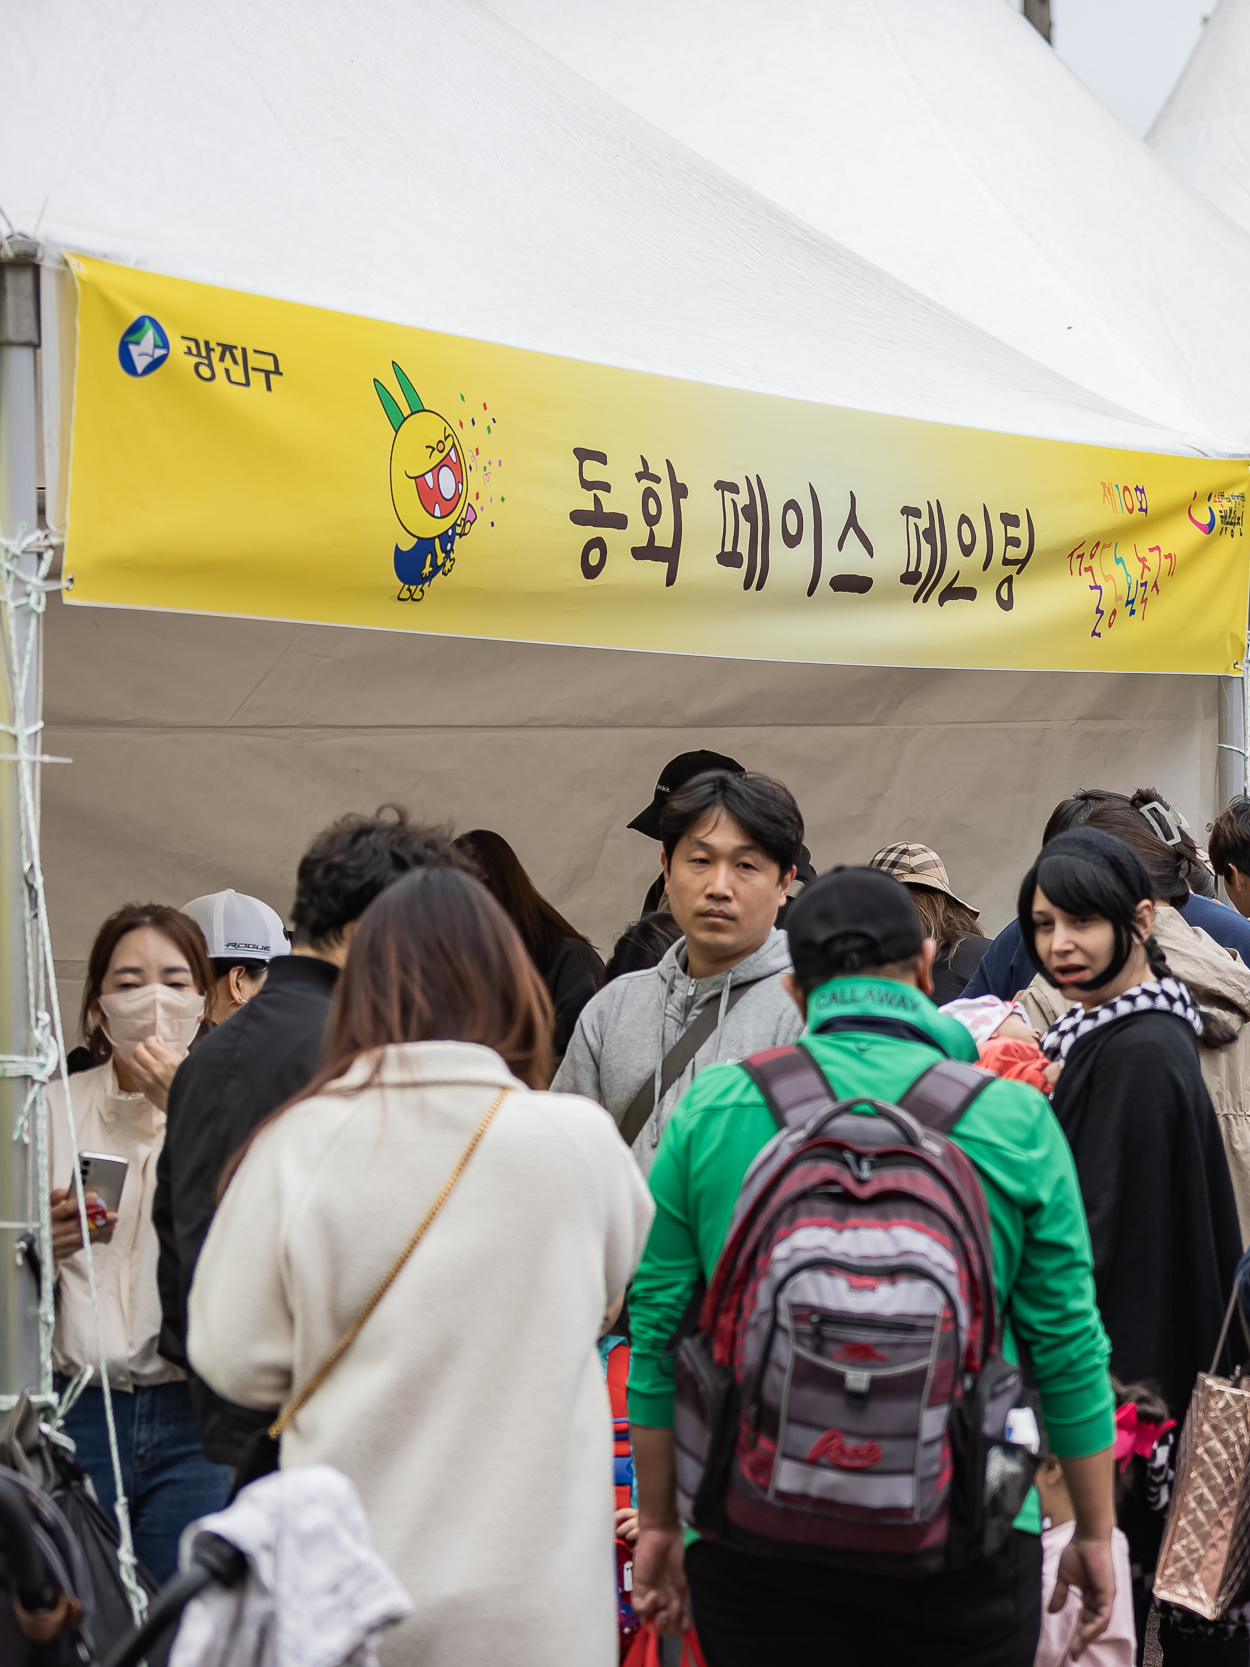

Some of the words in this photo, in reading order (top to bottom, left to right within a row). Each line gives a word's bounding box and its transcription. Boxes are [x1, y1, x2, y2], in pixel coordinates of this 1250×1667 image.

[180, 335, 284, 393] 광진구
[1100, 481, 1149, 518] 제10회
[568, 446, 689, 588] 동화
[713, 473, 874, 598] 페이스
[899, 498, 1036, 612] 페인팅
[224, 942, 271, 952] ROGUE
[815, 986, 922, 1012] CALLAWAY
